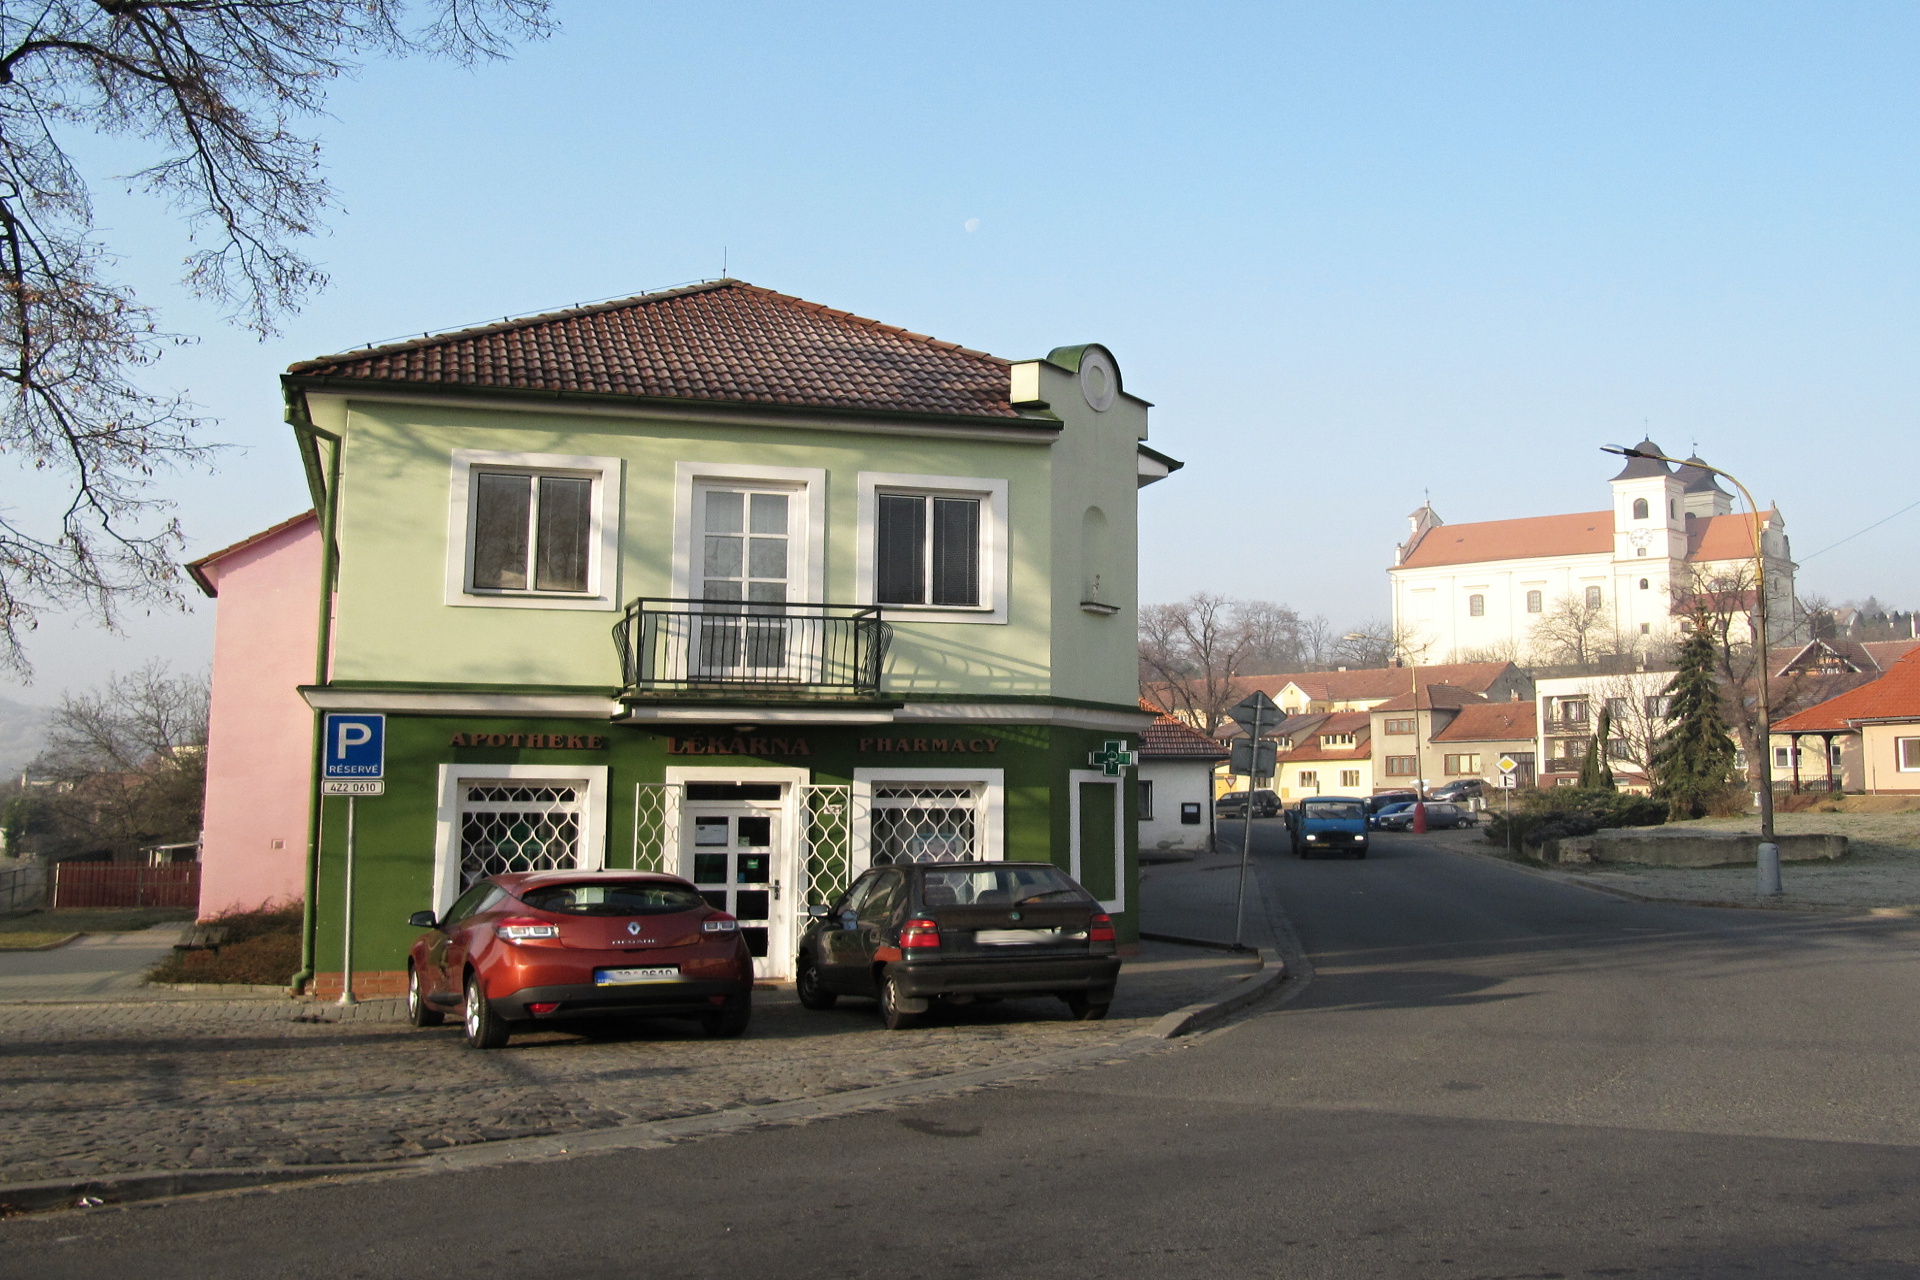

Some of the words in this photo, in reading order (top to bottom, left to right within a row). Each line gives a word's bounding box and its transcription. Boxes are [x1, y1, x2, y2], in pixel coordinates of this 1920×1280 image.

[338, 722, 372, 759] P
[450, 732, 604, 749] APOTHEKE
[859, 738, 999, 752] PHARMACY
[329, 764, 379, 774] RÉSERVÉ
[330, 783, 349, 792] 4Z2
[353, 783, 376, 792] 0610
